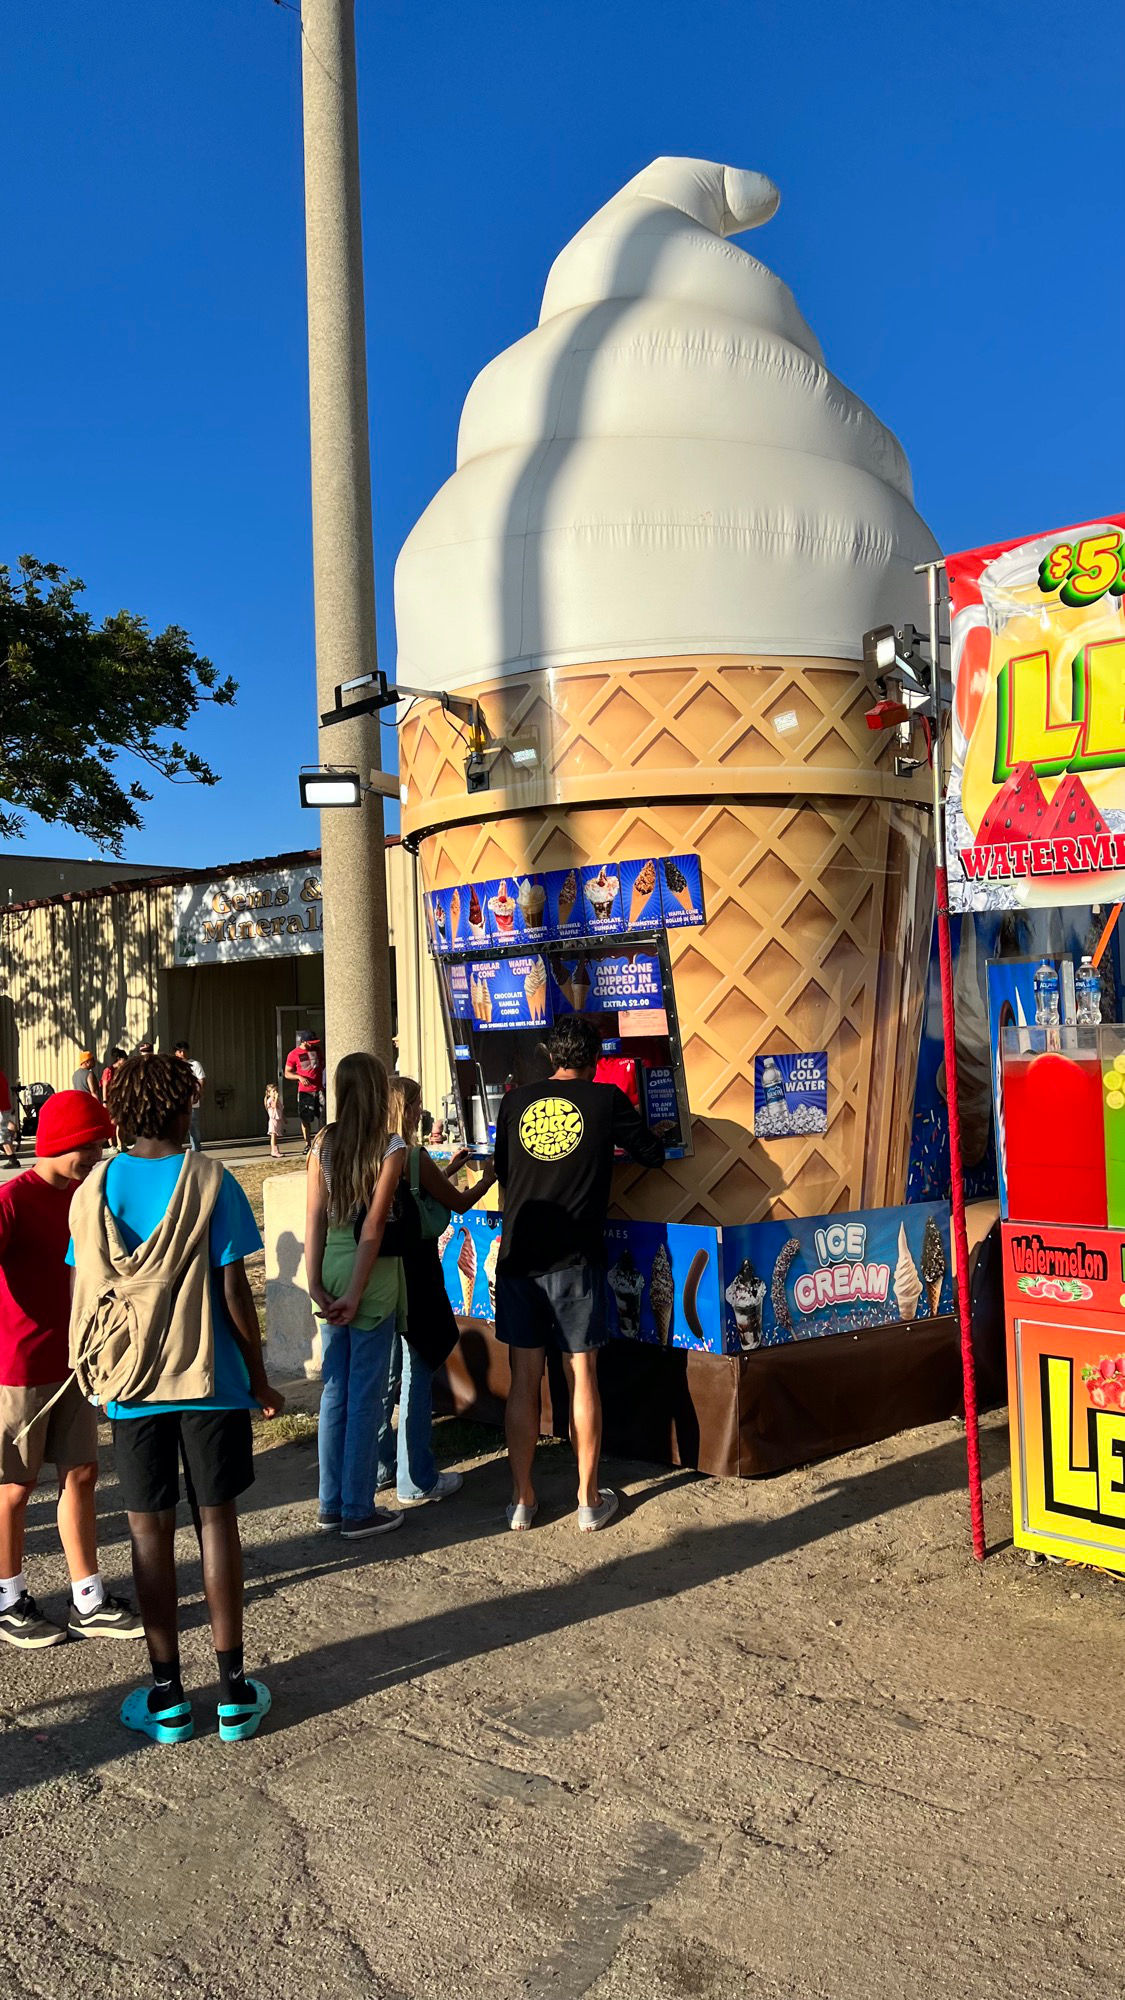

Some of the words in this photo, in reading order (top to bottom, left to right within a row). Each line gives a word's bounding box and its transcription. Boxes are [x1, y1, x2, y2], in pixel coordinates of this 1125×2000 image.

[212, 887, 289, 914] Gems
[300, 877, 323, 902] &
[202, 906, 323, 943] Mineral
[556, 922, 581, 930] SPRINKLE
[589, 916, 621, 926] CHOCOLATE
[628, 920, 659, 928] DRUMSTICK
[559, 928, 579, 936] WAFFLE
[472, 962, 500, 972] REGULAR
[508, 958, 532, 969] WAFFLE
[478, 970, 496, 979] CONE
[512, 966, 531, 976] CONE
[596, 965, 619, 976] ANY
[621, 963, 653, 974] CONE
[598, 974, 636, 986] DIPPED
[638, 974, 652, 983] IN
[593, 983, 658, 996] CHOCOLATE
[494, 991, 523, 1000] CHOCOLATE
[603, 999, 627, 1008] EXTRA
[628, 998, 650, 1007] $2.00
[501, 1008, 520, 1016] COMBO
[796, 1058, 815, 1069] ICE
[650, 1069, 670, 1078] ADD
[789, 1069, 821, 1081] COLD
[785, 1080, 826, 1092] WATER
[523, 1099, 573, 1123] RIP
[521, 1112, 582, 1139] CURL
[476, 1216, 503, 1227] FLOA
[814, 1222, 866, 1267] ICE
[794, 1263, 890, 1314] CREAM
